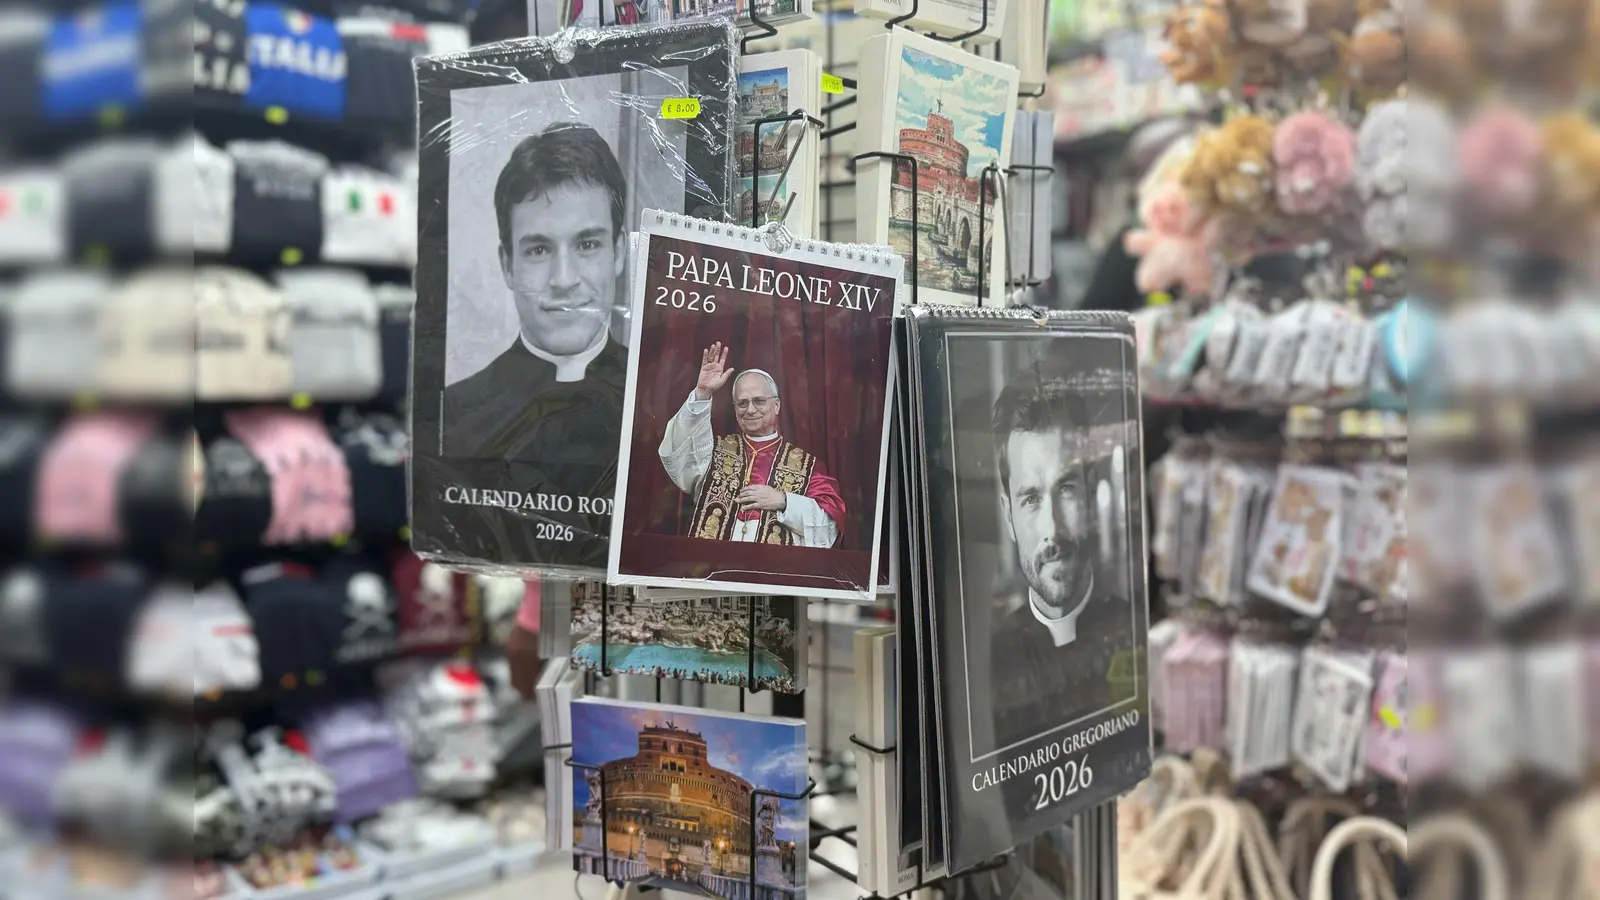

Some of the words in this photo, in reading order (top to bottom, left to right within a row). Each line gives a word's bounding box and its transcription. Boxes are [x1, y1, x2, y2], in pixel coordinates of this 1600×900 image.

[676, 103, 695, 113] 8.00
[666, 251, 735, 289] PAPA
[740, 264, 832, 305] LEONE
[837, 281, 881, 313] XIV
[655, 286, 716, 314] 2026
[445, 486, 573, 513] CALENDARIO
[536, 523, 574, 542] 2026
[972, 742, 1060, 792] CALENDARIO
[1062, 708, 1140, 755] GREGORIANO
[1034, 753, 1093, 811] 2026
